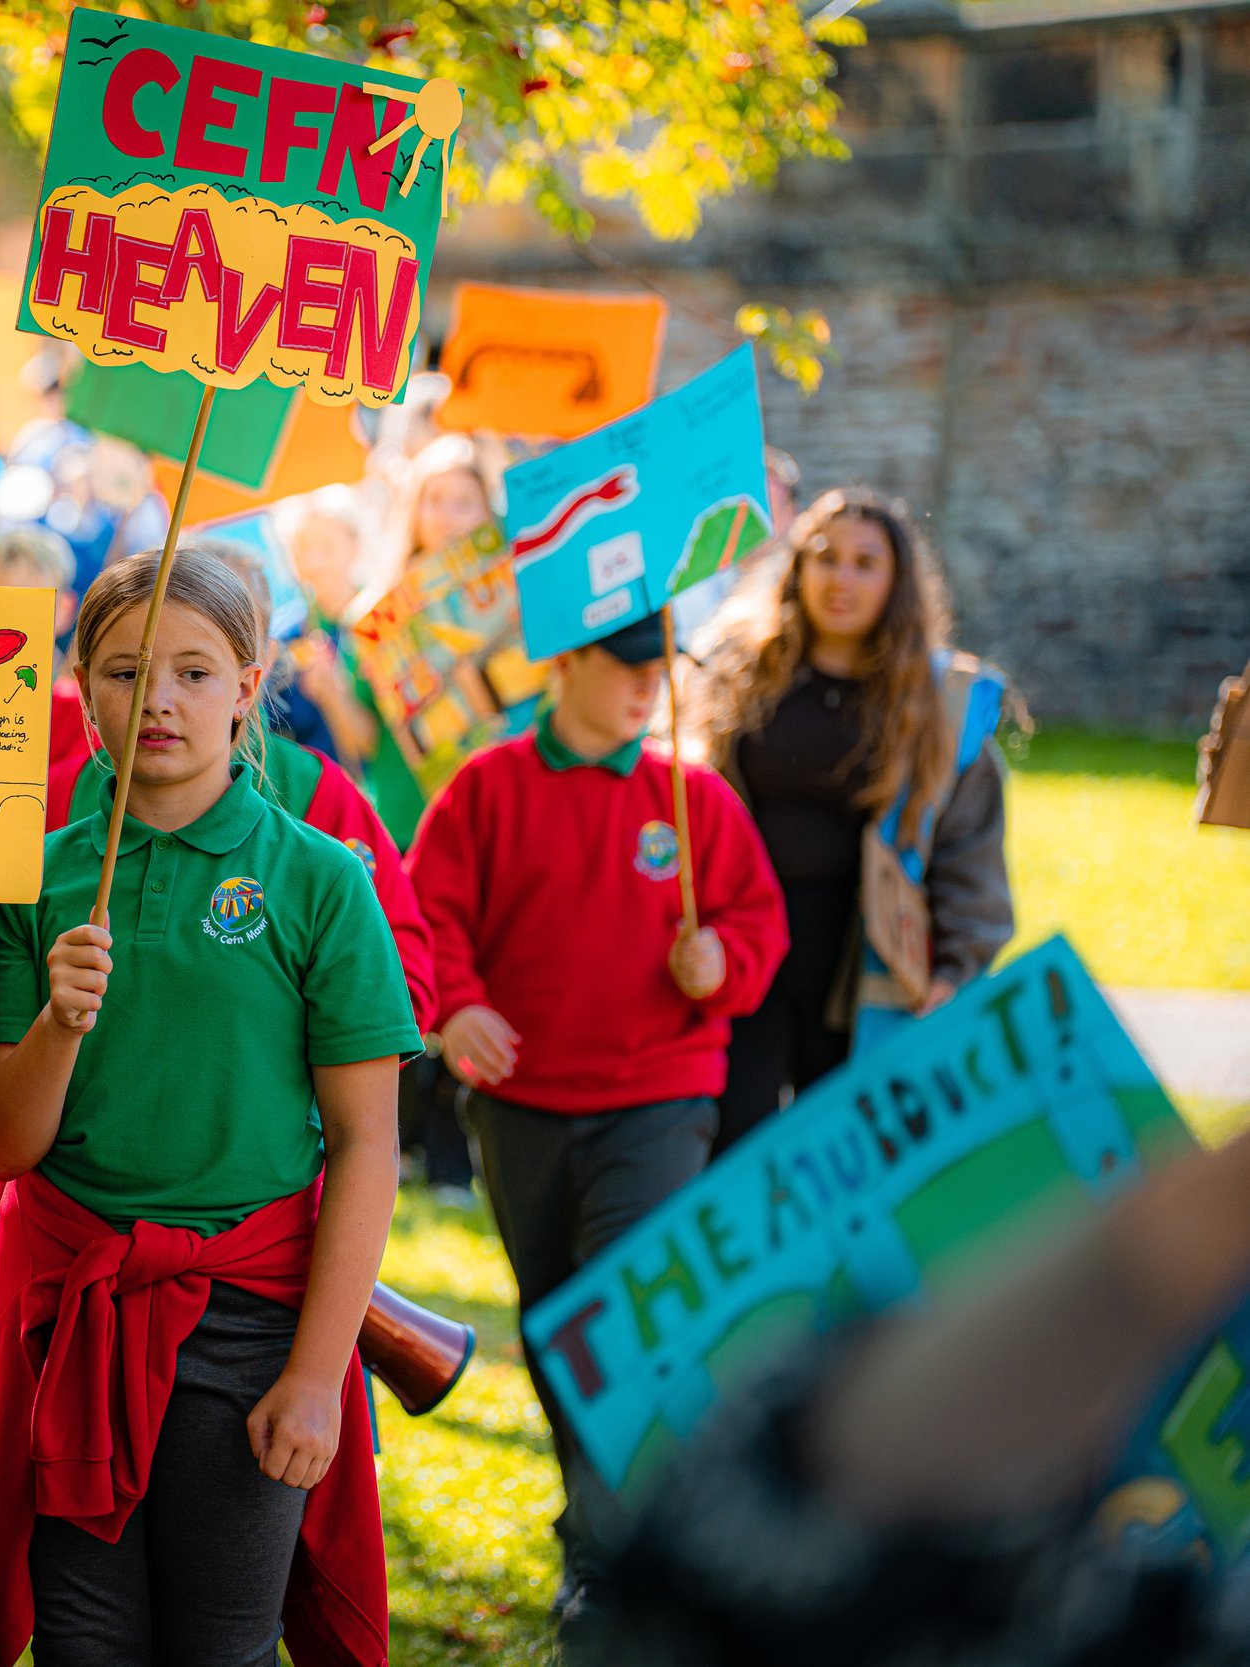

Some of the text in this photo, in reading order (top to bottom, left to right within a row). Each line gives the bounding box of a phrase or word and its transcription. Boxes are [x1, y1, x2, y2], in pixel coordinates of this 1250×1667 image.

[102, 48, 408, 212] CEFN
[33, 205, 421, 392] HEAVEN
[14, 713, 25, 725] is
[200, 916, 269, 945] Ysgol Cefn Mawr
[550, 1201, 750, 1399] THE
